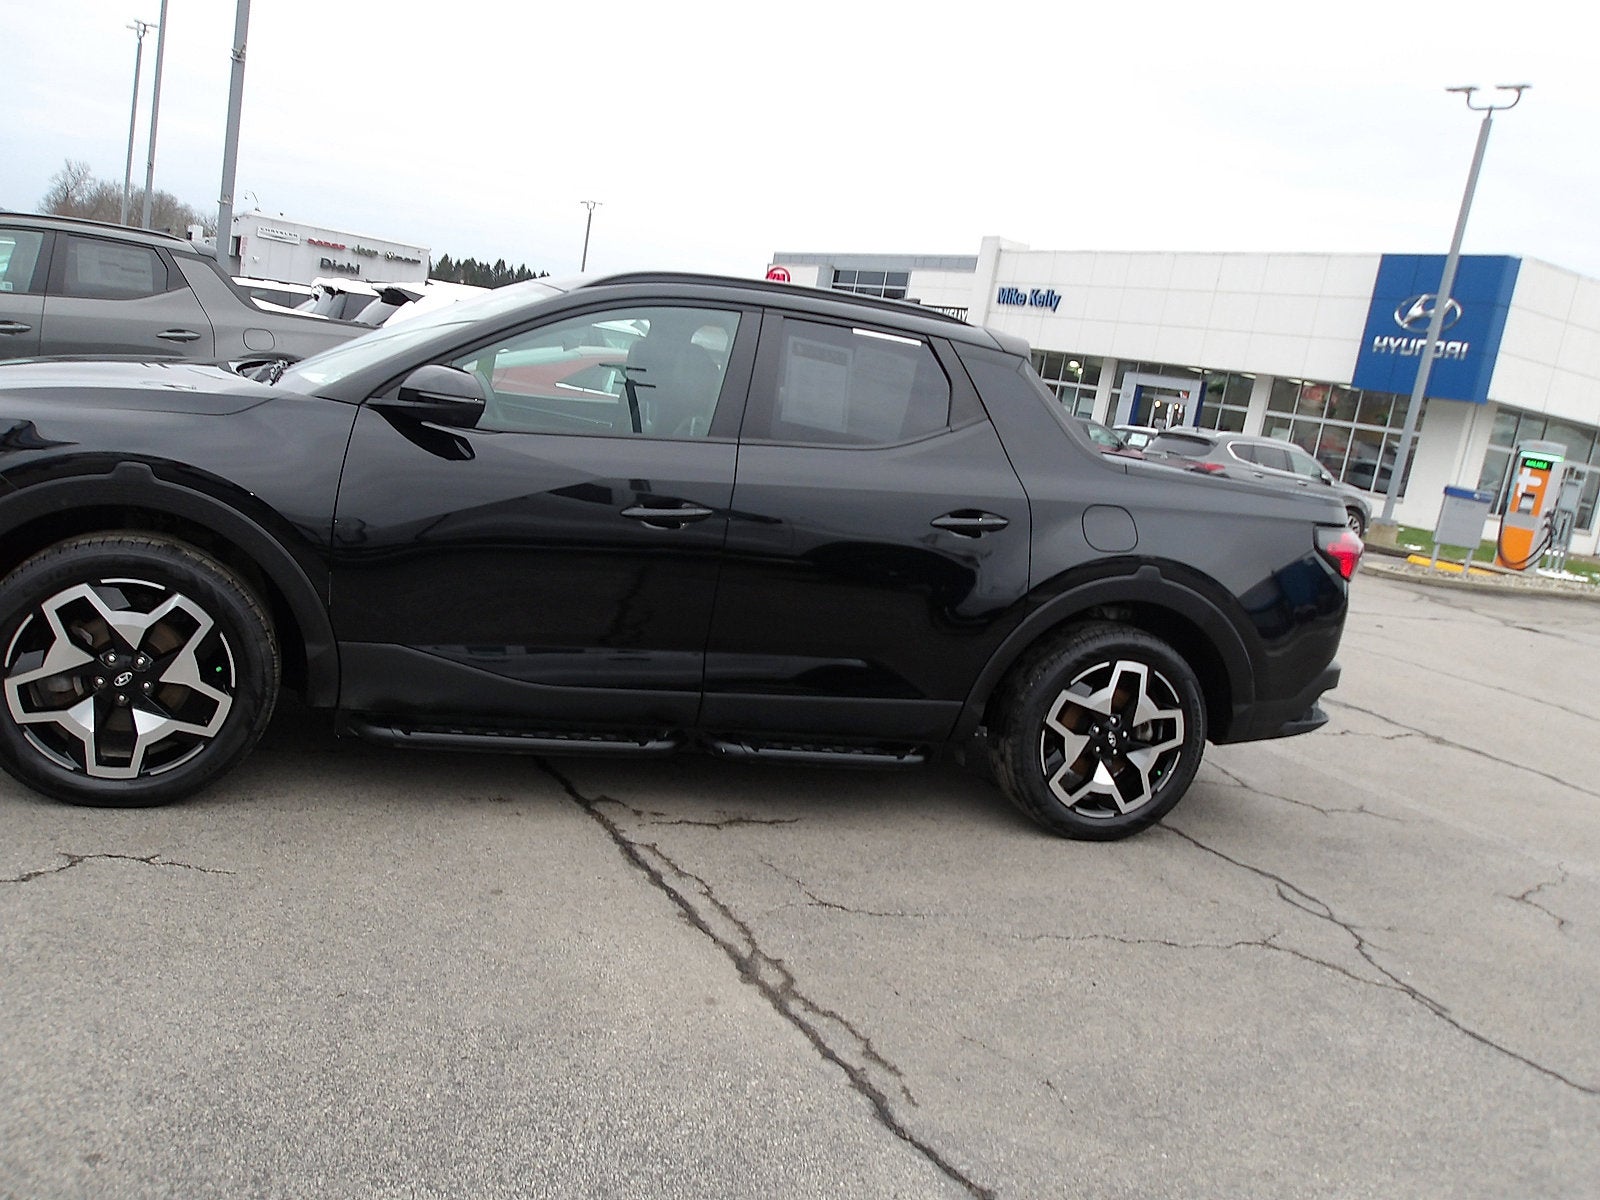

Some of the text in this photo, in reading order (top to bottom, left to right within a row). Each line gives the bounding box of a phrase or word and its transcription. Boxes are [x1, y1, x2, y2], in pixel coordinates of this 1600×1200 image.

[320, 257, 361, 275] Diehl
[997, 286, 1062, 313] Mike Kelly
